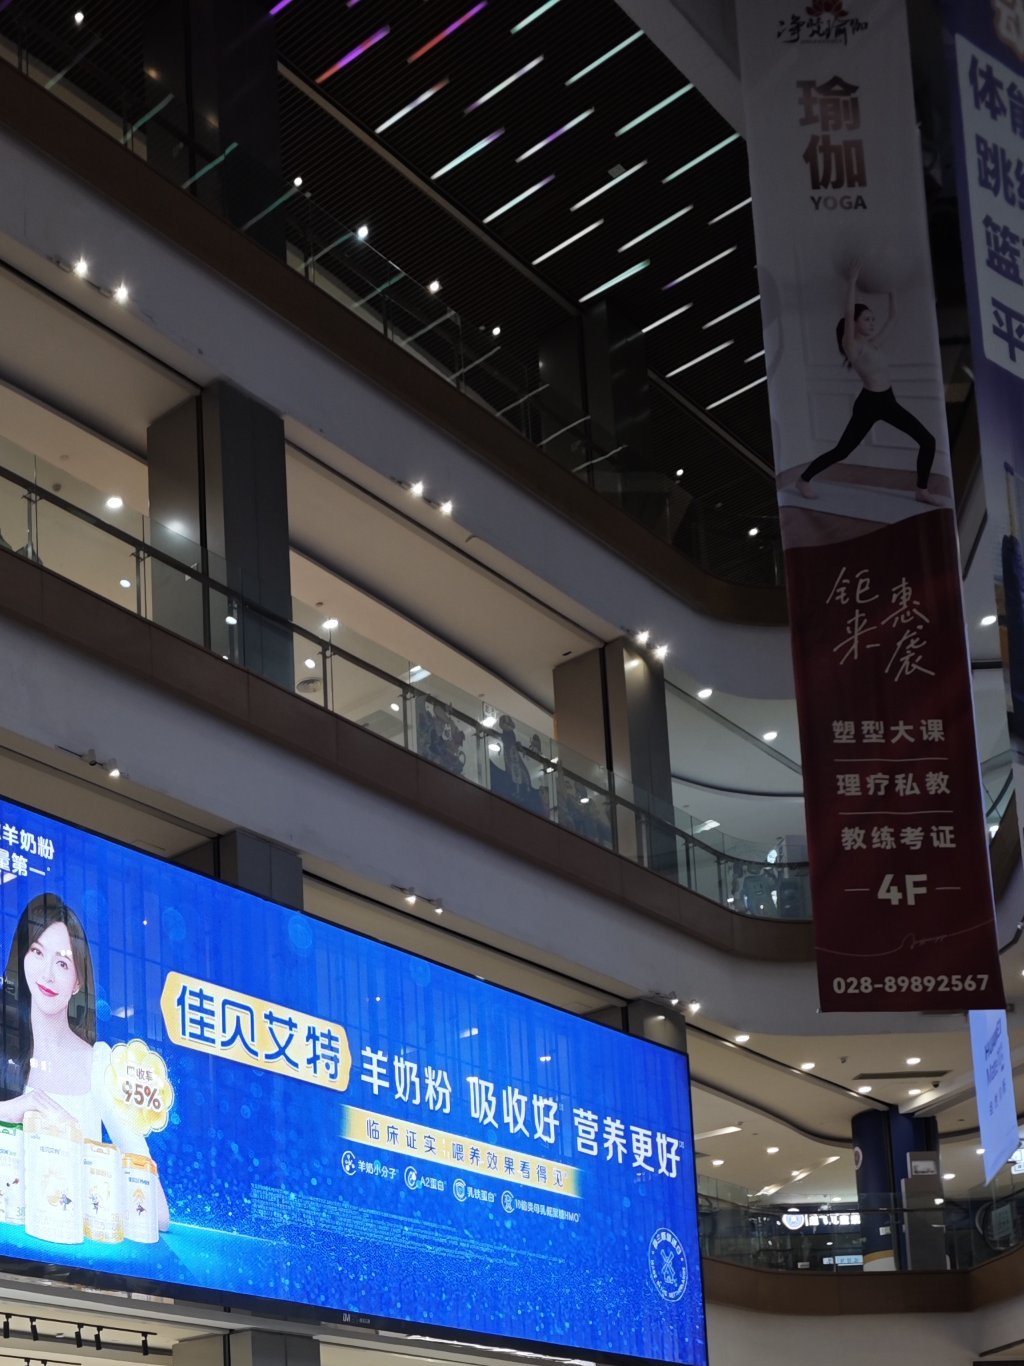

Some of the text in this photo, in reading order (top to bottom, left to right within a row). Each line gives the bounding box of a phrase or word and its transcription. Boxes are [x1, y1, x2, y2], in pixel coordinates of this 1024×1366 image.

[796, 75, 867, 190] 瑜伽
[810, 195, 868, 210] YOGA
[831, 719, 946, 744] 塑型大课
[836, 772, 951, 797] 理疗私教
[840, 826, 957, 851] 教练考证
[876, 874, 928, 906] 4F
[832, 974, 990, 995] 028-89892567
[176, 984, 340, 1081] 佳贝艾特
[361, 1046, 682, 1179] 羊奶粉 吸收好 营养更好
[366, 1117, 437, 1156] 临床证实
